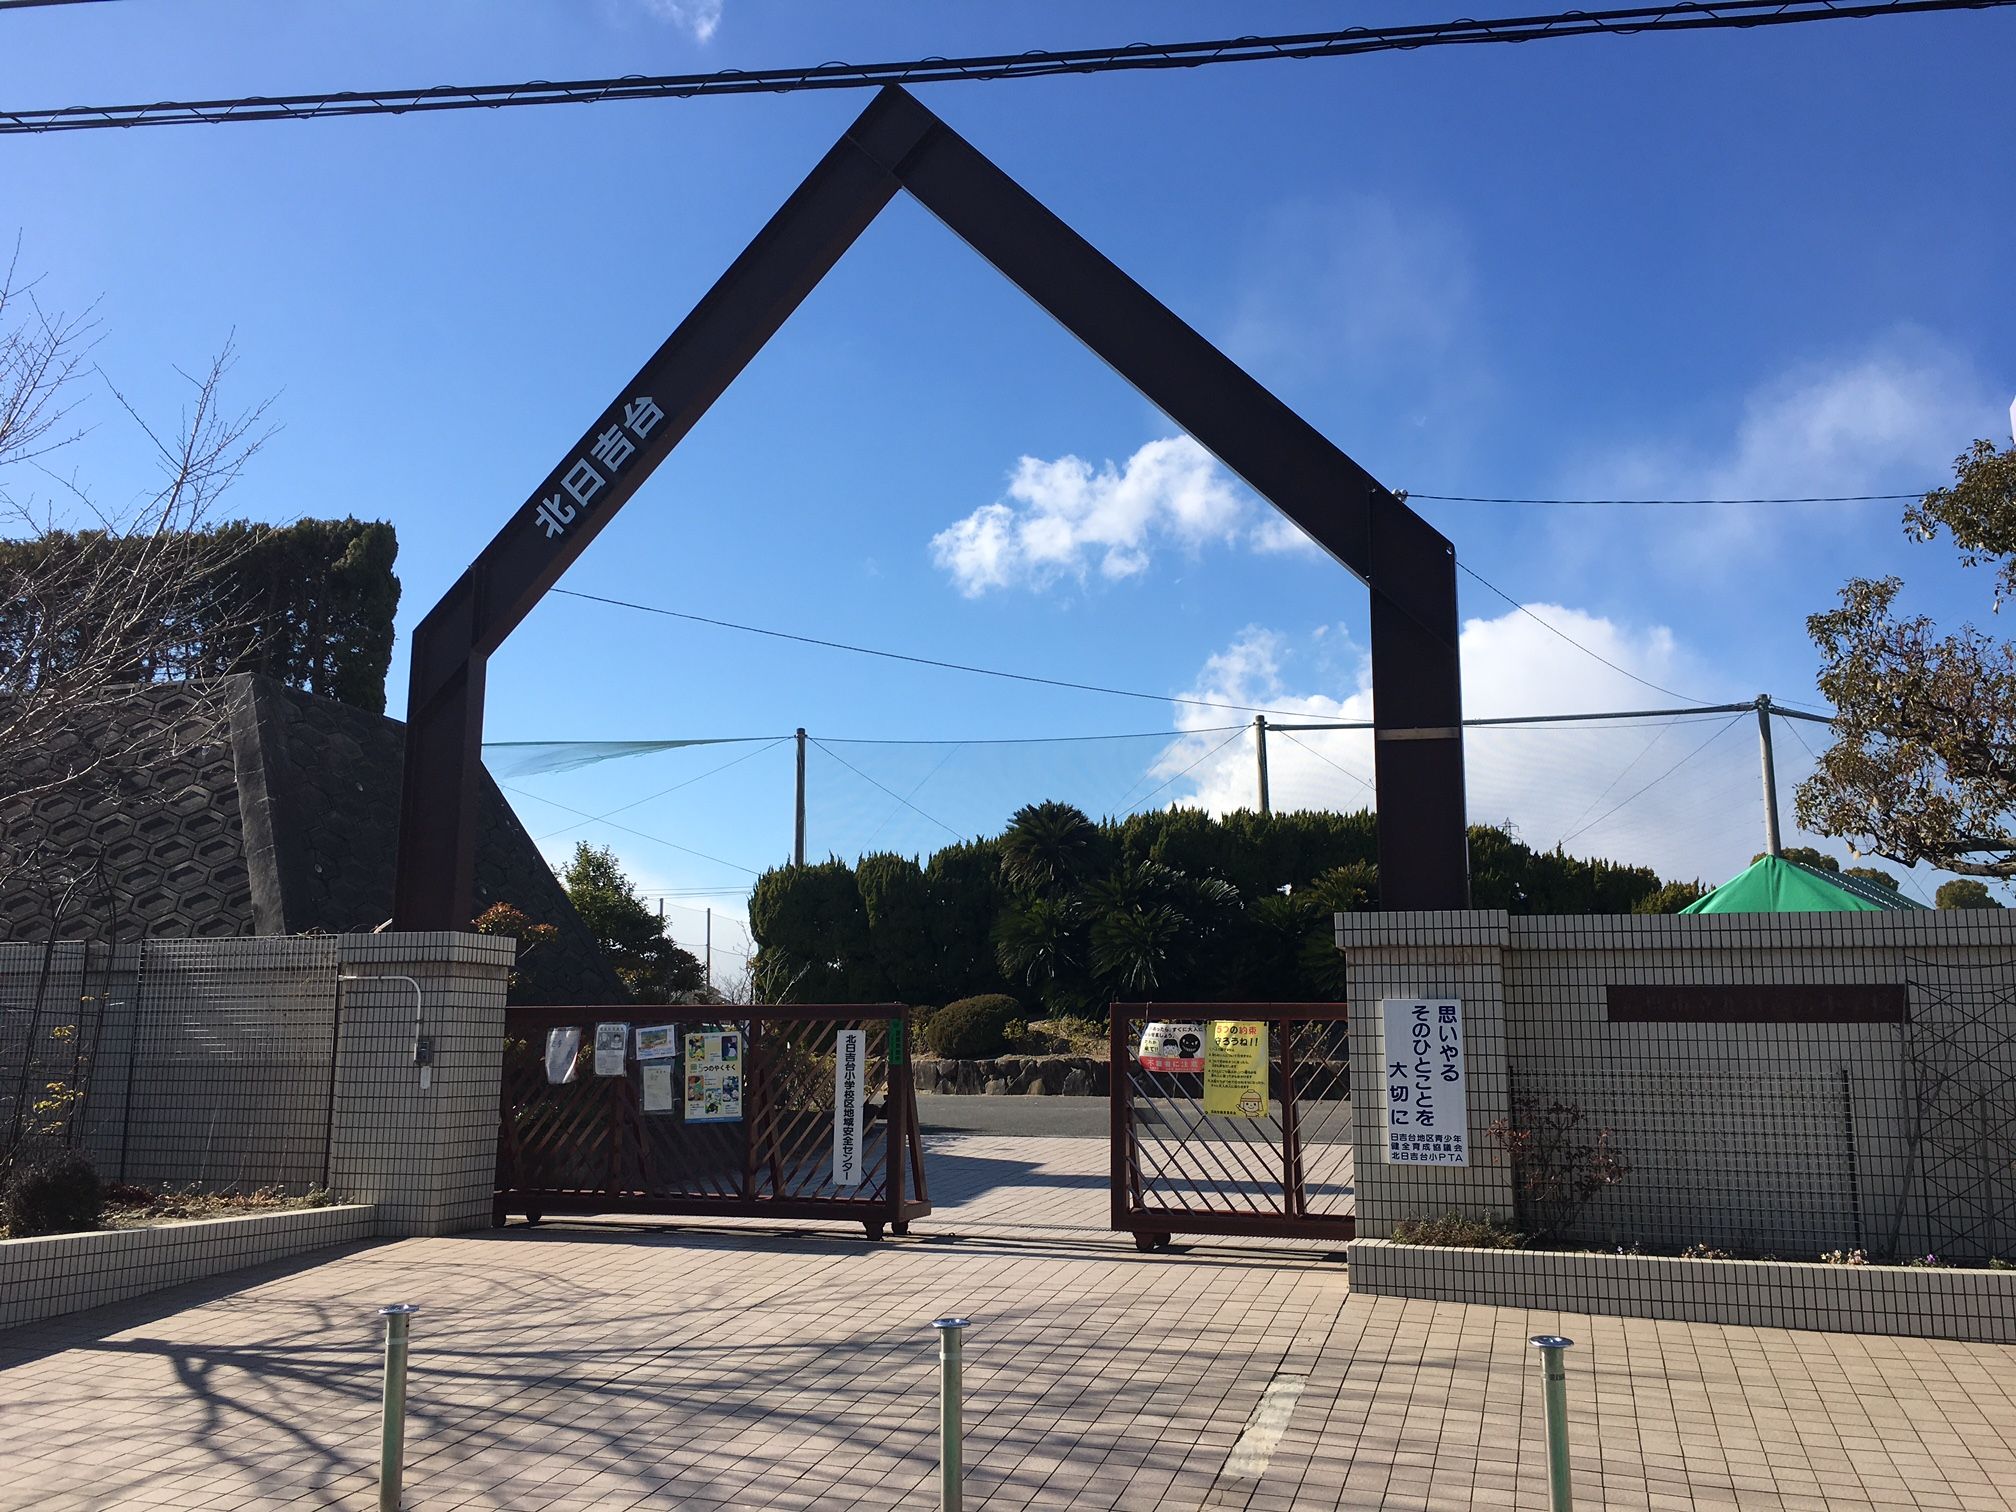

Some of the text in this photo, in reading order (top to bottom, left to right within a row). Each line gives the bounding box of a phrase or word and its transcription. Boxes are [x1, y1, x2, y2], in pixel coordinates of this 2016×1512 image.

[534, 396, 665, 539] 北日吉台
[1216, 1025, 1258, 1035] 5つの約束
[1438, 1005, 1460, 1082] 思いやる
[1389, 1061, 1410, 1126] 大切に
[1411, 1005, 1435, 1127] そのひとことを
[842, 1034, 857, 1181] 北日吉台小学校区地域安全センター
[1391, 1132, 1462, 1143] 日吉台地区青少年
[1391, 1142, 1463, 1153] 健全育成協議会
[1391, 1151, 1463, 1162] 北日吉台小PTA
